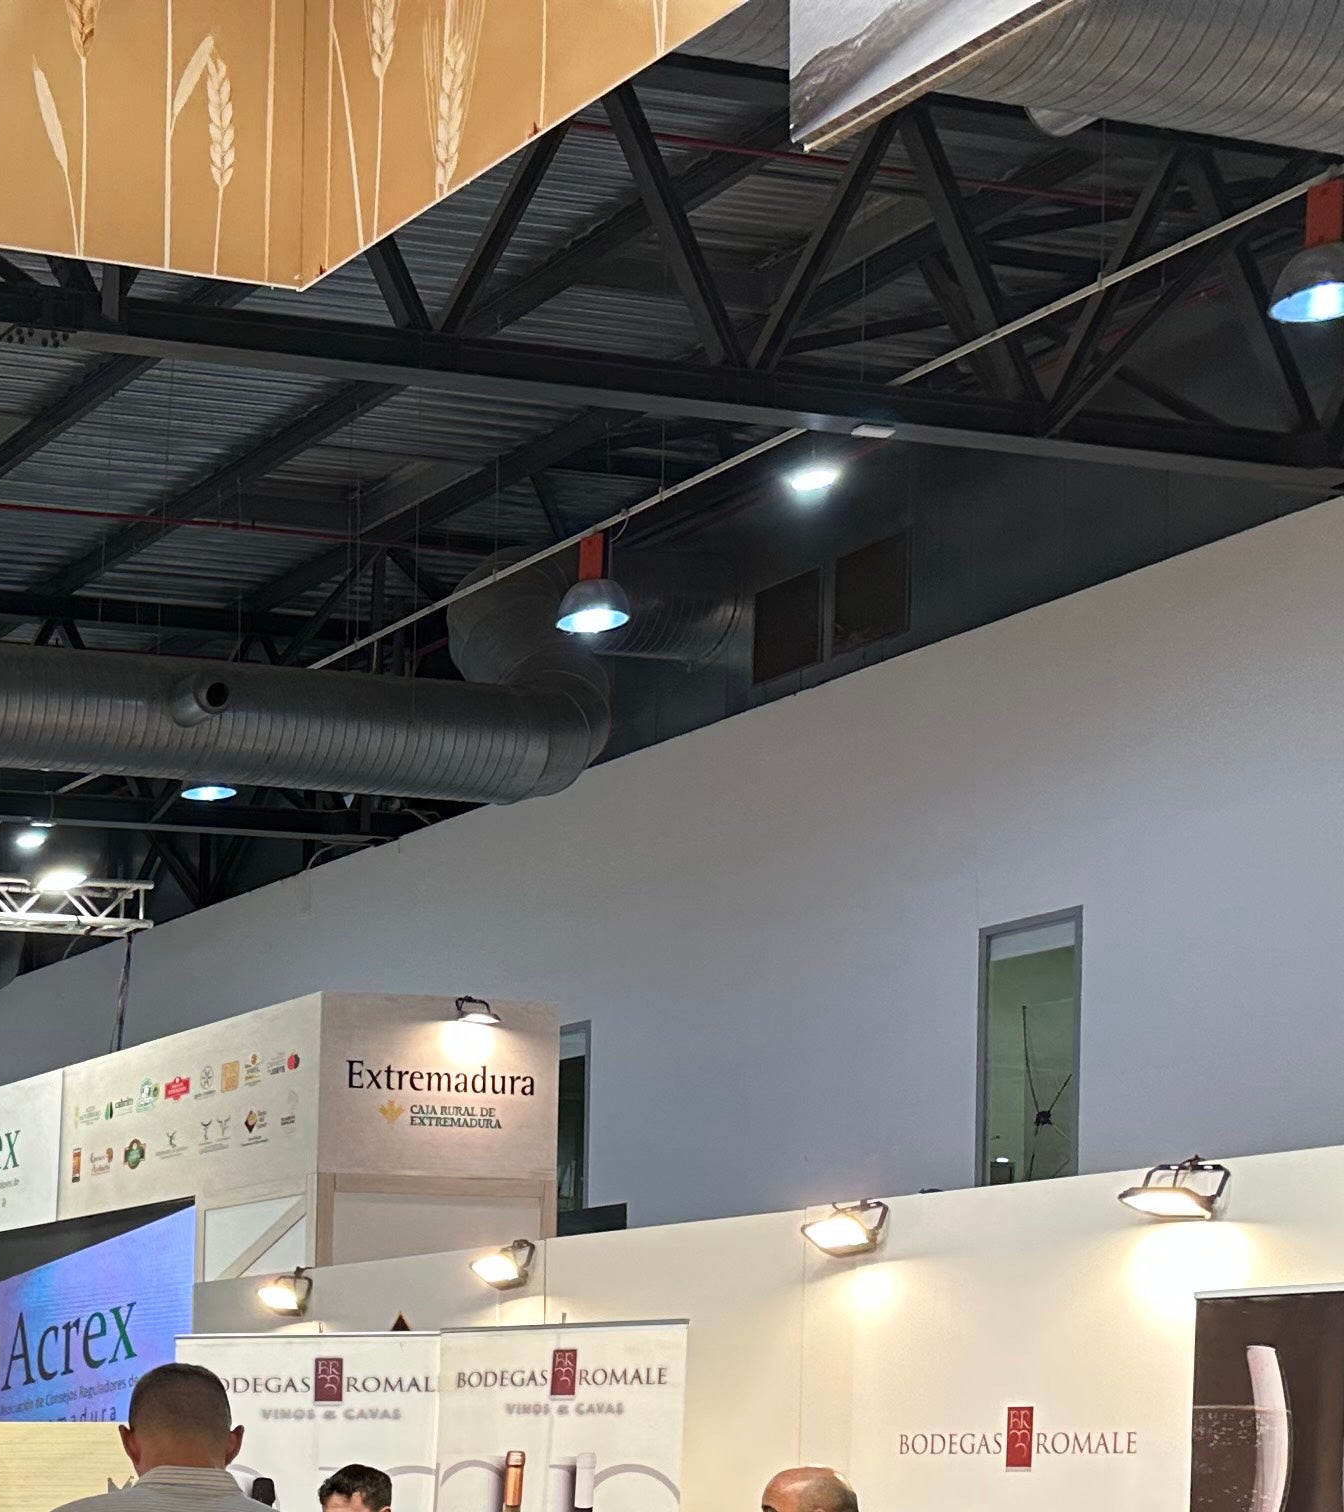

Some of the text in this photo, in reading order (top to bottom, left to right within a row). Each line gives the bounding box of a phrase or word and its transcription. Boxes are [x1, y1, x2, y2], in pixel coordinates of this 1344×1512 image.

[346, 1059, 534, 1096] Extremadura
[410, 1104, 496, 1118] CAJA RURAL DE
[410, 1116, 502, 1130] EXTREMADURA
[0, 1301, 138, 1392] Acrex
[222, 1376, 311, 1394] DEGAS
[346, 1376, 436, 1394] ROMAL
[457, 1369, 548, 1389] BODEGAS
[578, 1366, 668, 1386] ROMALE
[260, 1408, 317, 1421] VINOS
[344, 1408, 402, 1420] CAVAS
[505, 1403, 551, 1416] VINOS
[574, 1402, 625, 1416] CAVAS
[899, 1432, 1003, 1455] BODEGAS
[1036, 1431, 1138, 1455] ROMALE
